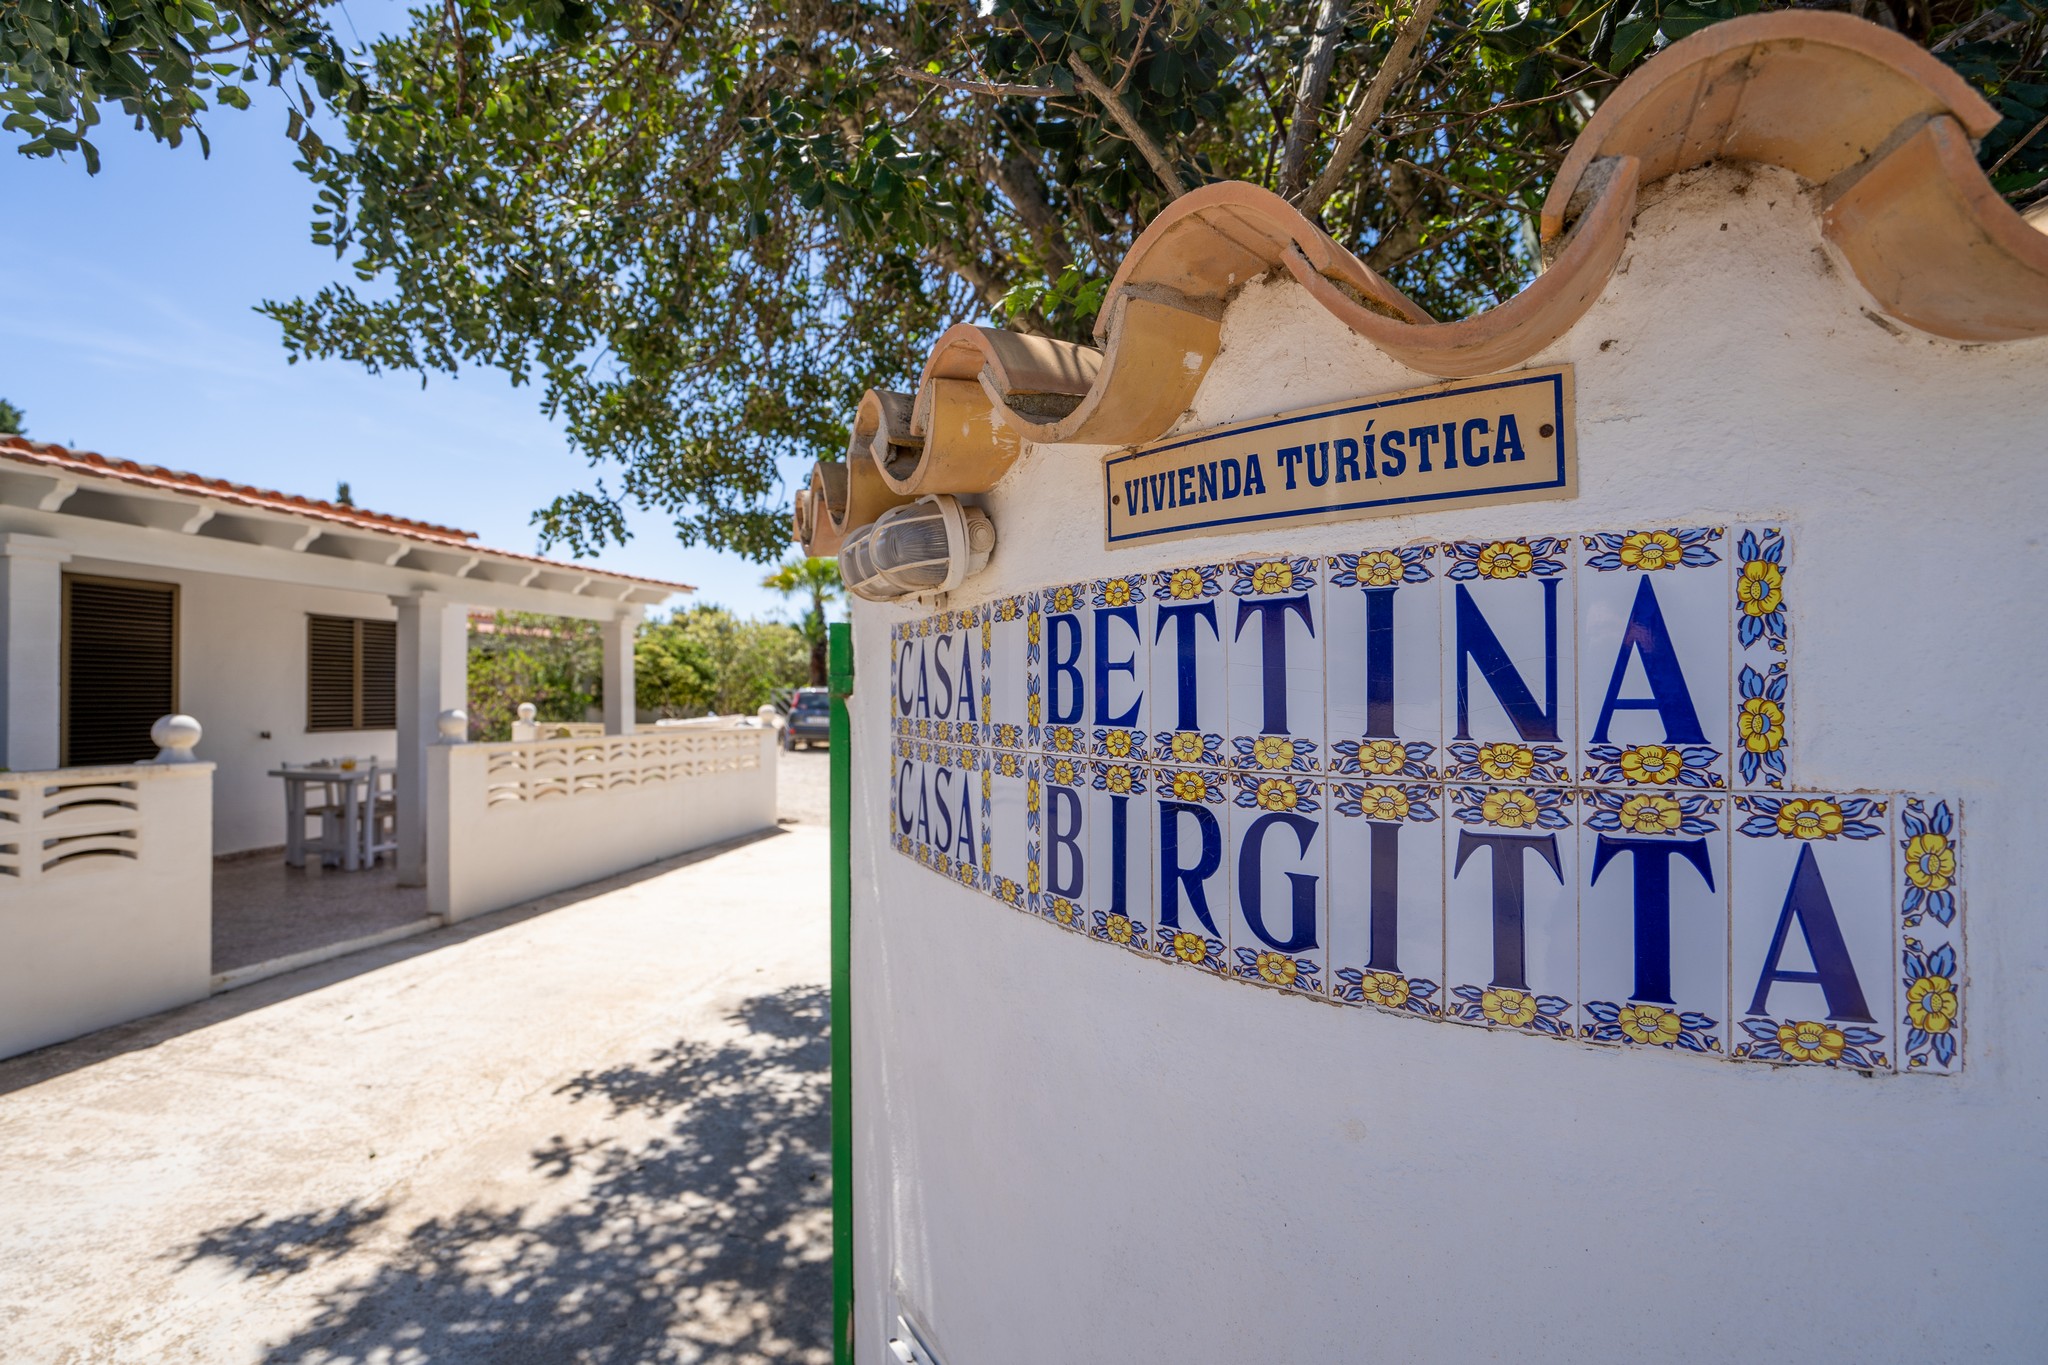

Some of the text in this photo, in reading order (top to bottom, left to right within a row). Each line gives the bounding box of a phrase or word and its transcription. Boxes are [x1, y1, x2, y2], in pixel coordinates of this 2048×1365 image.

[1124, 414, 1526, 517] VIVIENDA TURÍSTICA
[899, 574, 1712, 745] CASA BETTINA
[899, 759, 1878, 1024] CASA BIRGITTA
